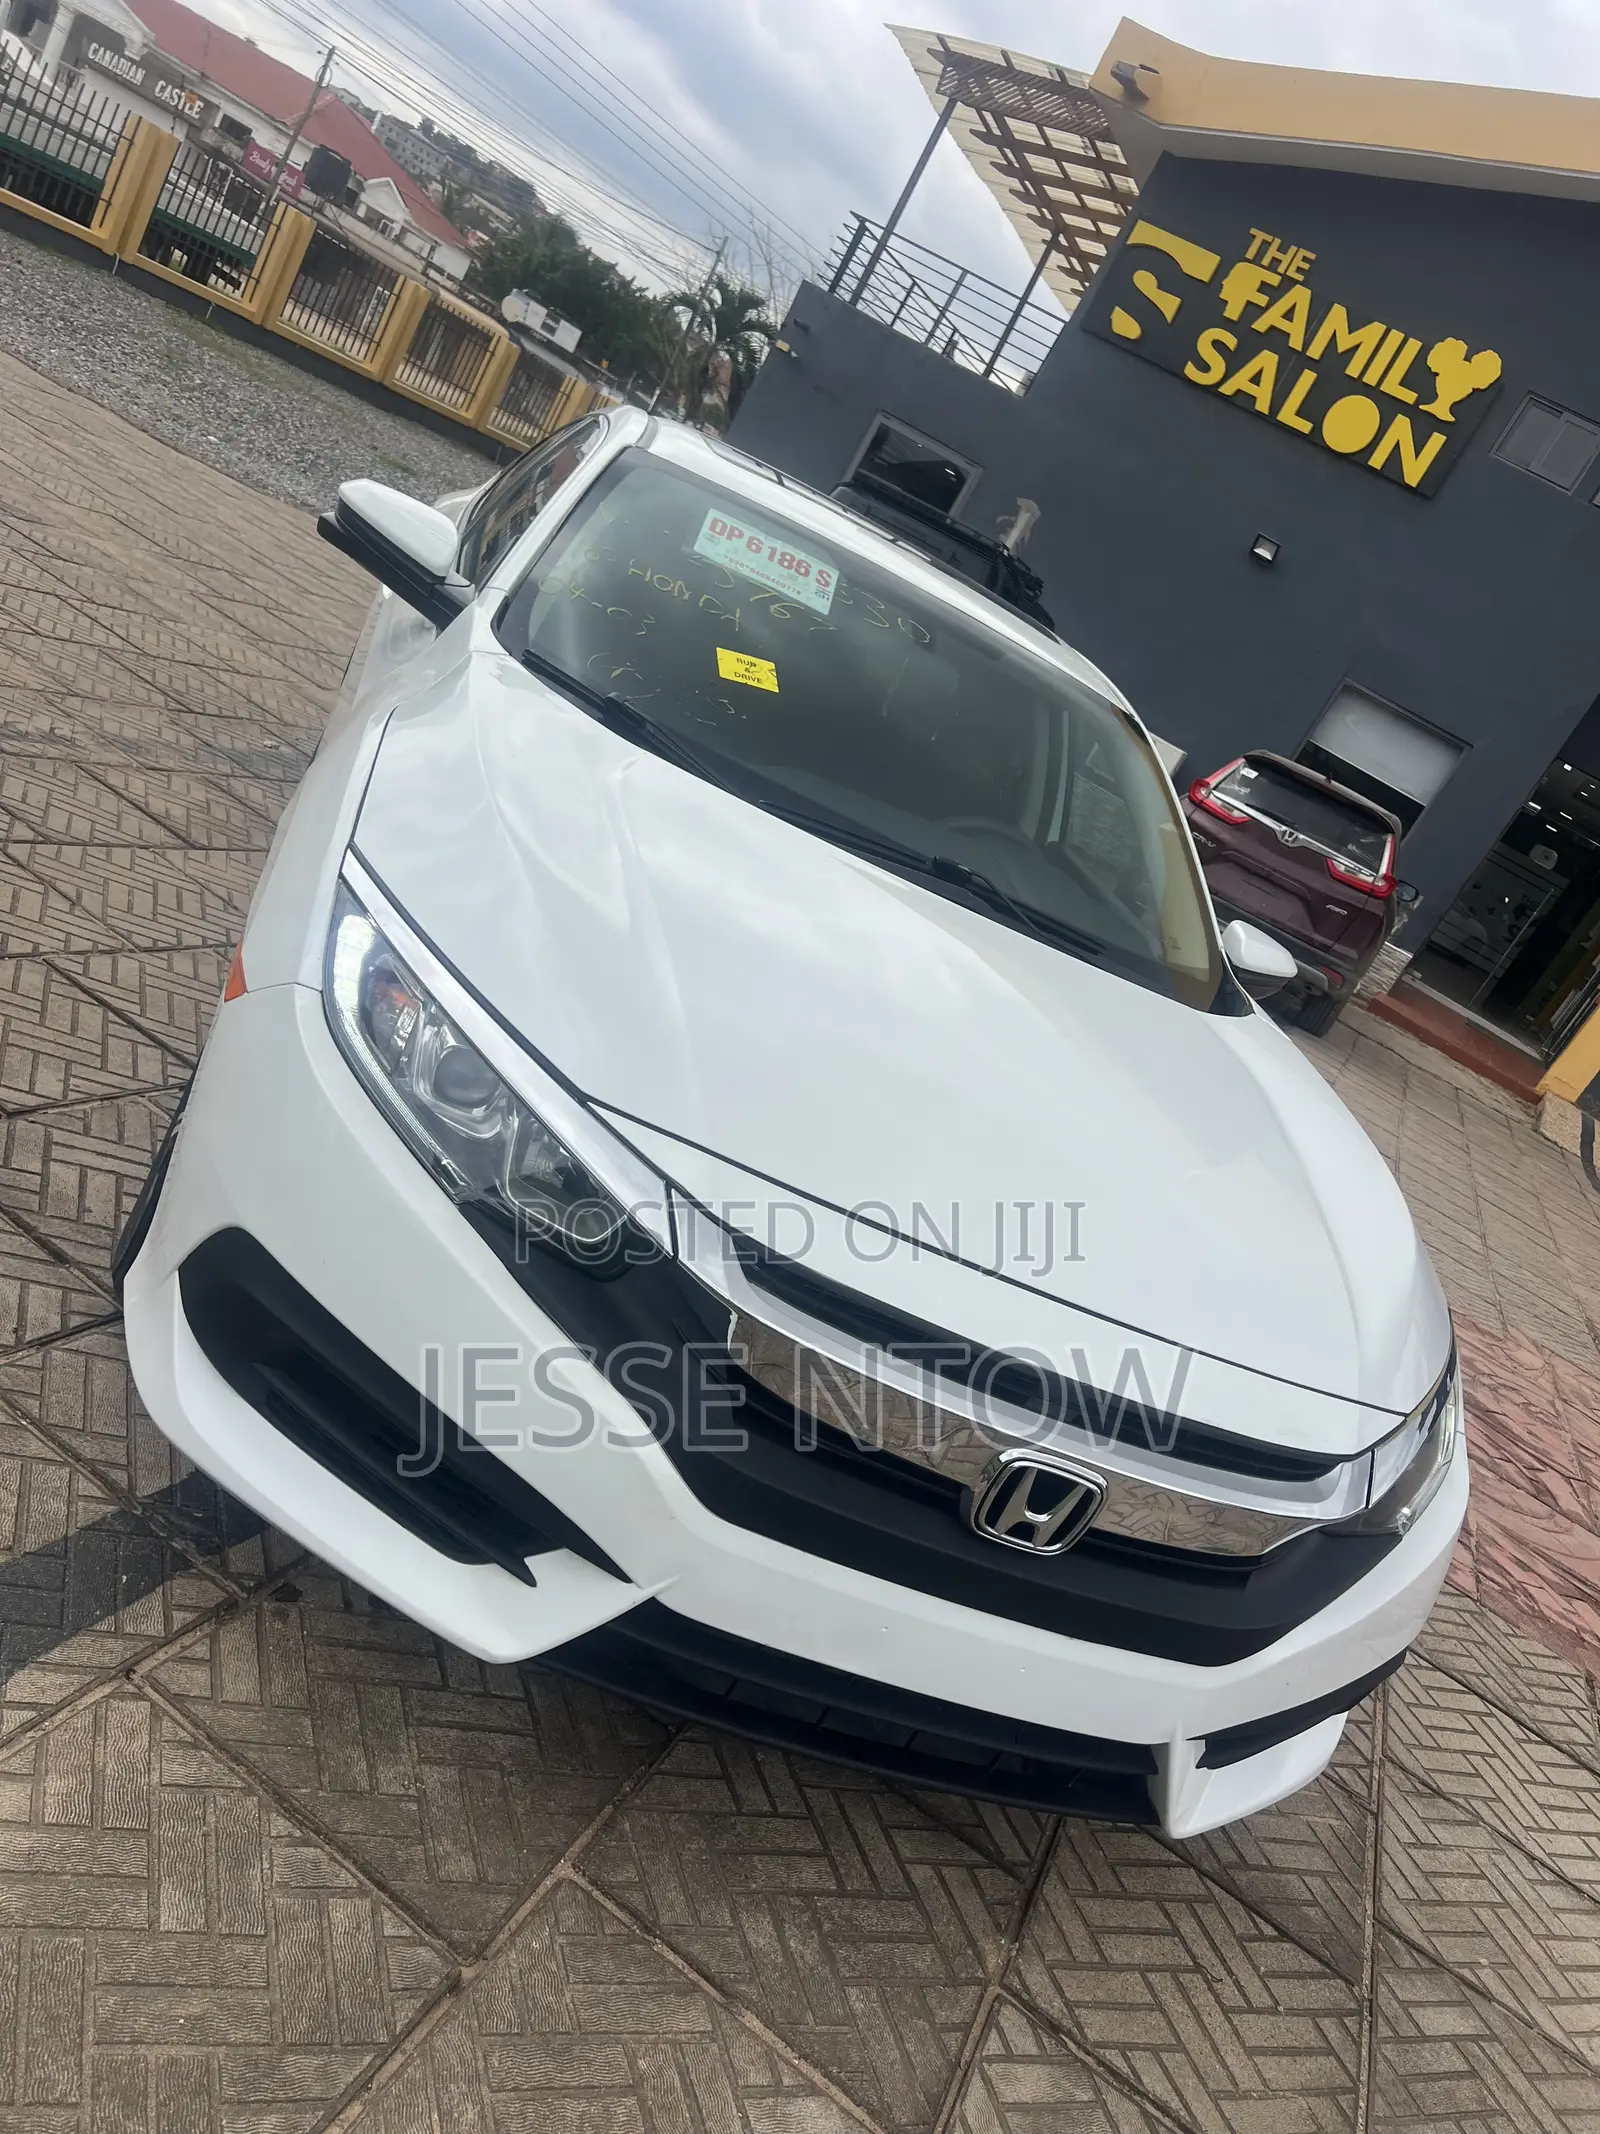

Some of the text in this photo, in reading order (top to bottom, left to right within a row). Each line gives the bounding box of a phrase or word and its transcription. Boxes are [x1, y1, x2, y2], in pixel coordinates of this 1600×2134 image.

[87, 42, 204, 119] CANADIAN CASTLE
[1244, 227, 1317, 282] THE
[1183, 327, 1447, 488] SALON
[708, 516, 745, 542] DP
[745, 535, 812, 578] 6186
[815, 569, 833, 588] S
[734, 671, 763, 684] DRIVE
